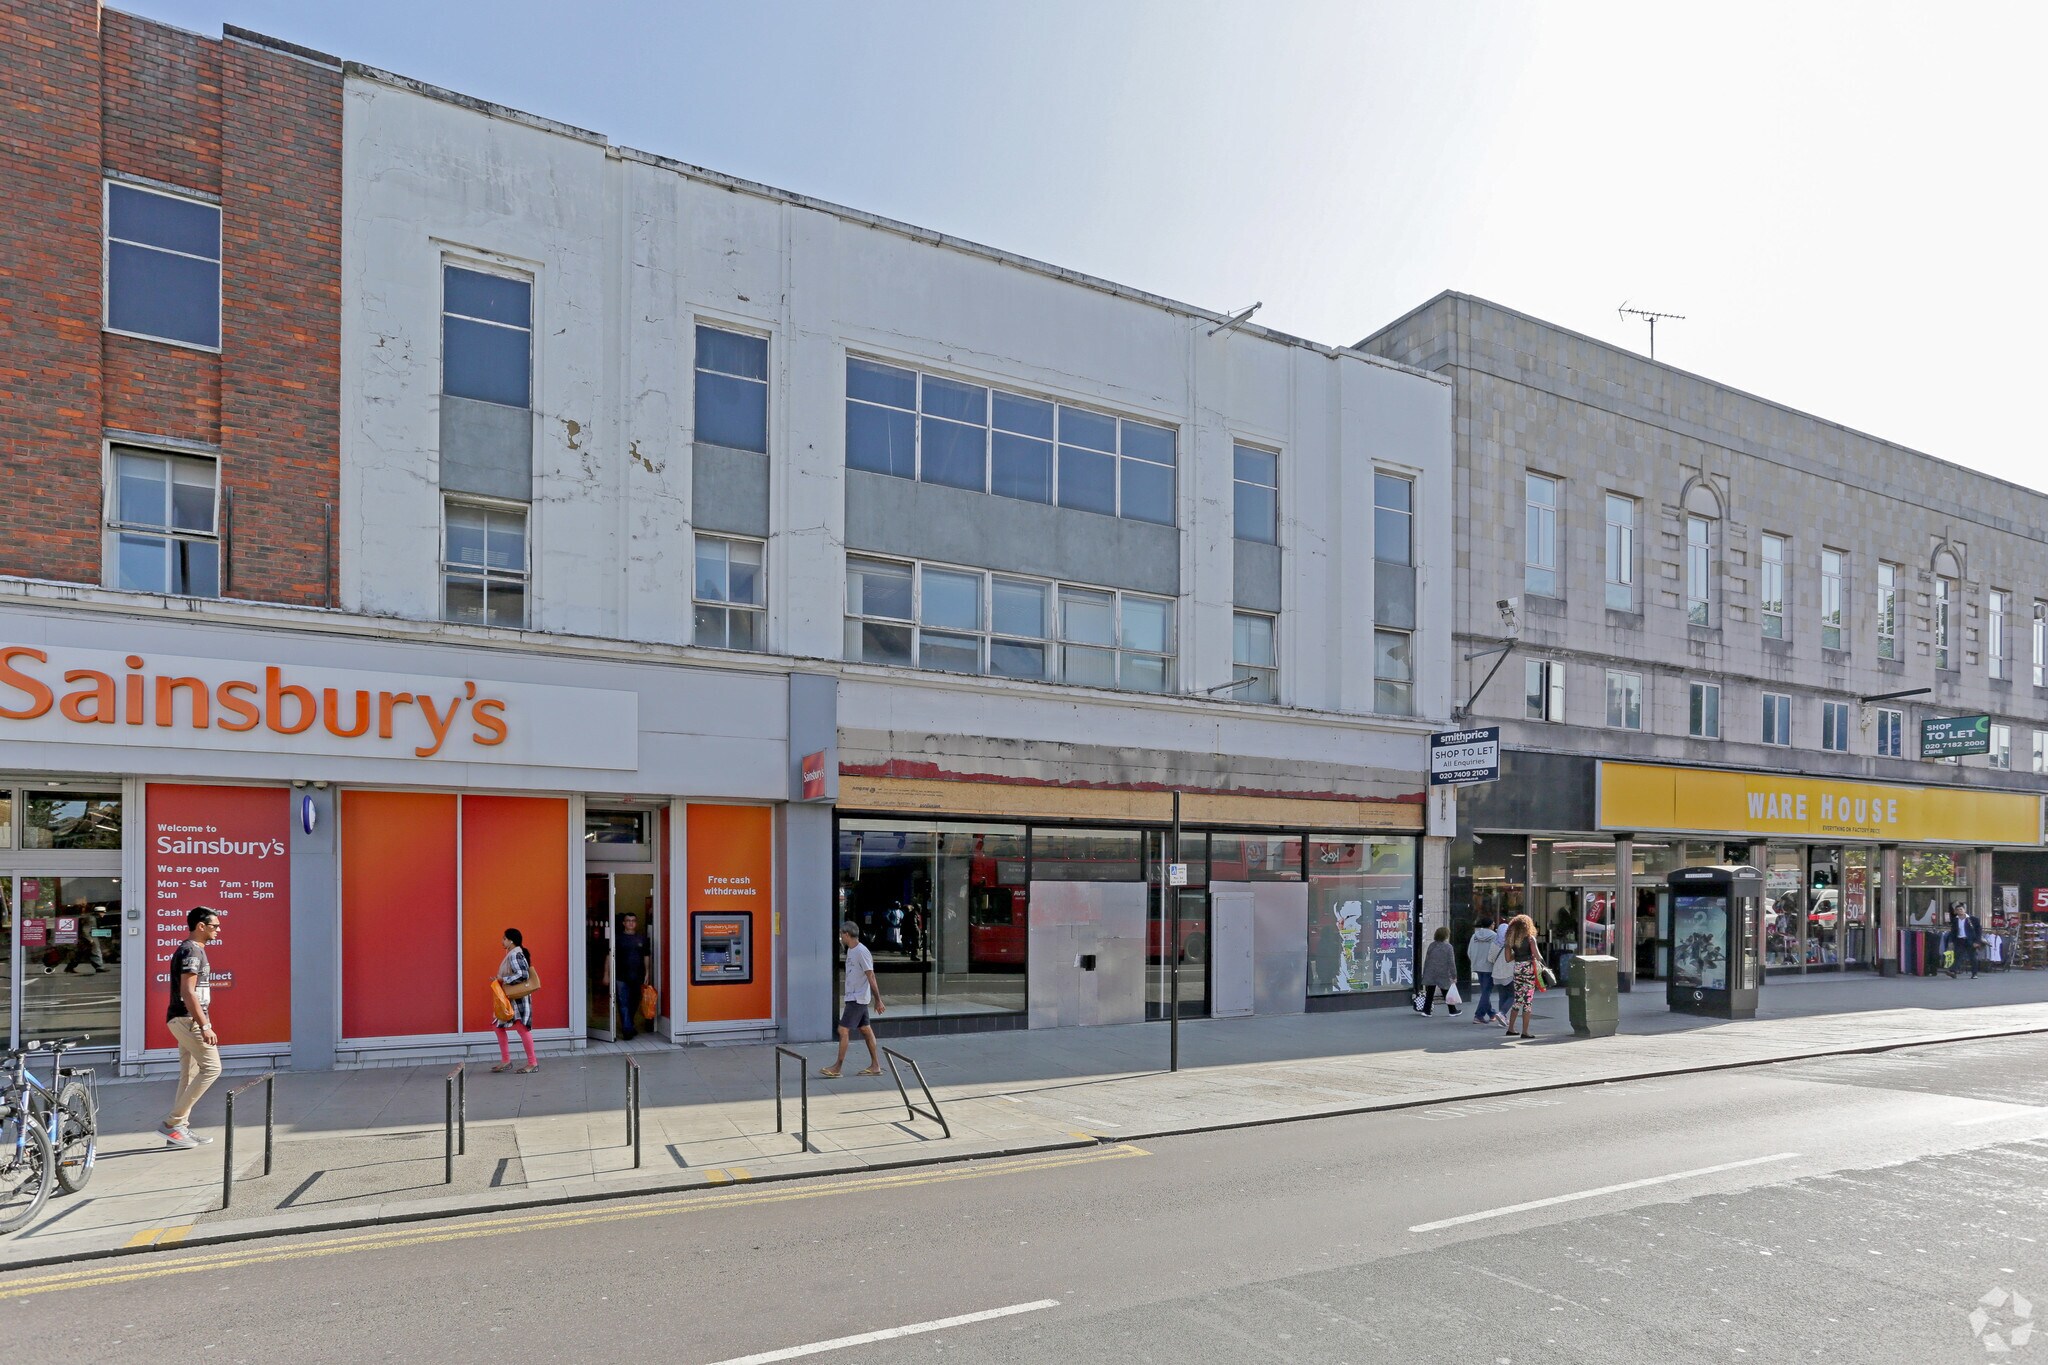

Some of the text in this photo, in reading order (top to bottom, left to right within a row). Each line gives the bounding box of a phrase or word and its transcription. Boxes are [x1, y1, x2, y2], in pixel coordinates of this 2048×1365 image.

[0, 646, 508, 757] Sainsbury's
[1927, 723, 1951, 731] SHOP
[1440, 730, 1489, 743] smithprice
[1926, 729, 1975, 740] TO LET
[1435, 746, 1494, 759] SHOP TO LET
[1454, 759, 1485, 767] Enquiries
[803, 767, 825, 783] Sainsbury's
[1747, 792, 1897, 823] WARE HOUSE
[157, 823, 203, 832] Welcome
[157, 836, 285, 859] Sainsbury's
[157, 865, 173, 873] We
[195, 866, 219, 874] open
[157, 880, 179, 888] Mon
[189, 880, 207, 888] Sat
[220, 880, 241, 888] 7am
[251, 880, 274, 889] 11pm
[708, 876, 750, 884] Free cash
[253, 891, 274, 899] 5pm
[704, 887, 756, 895] withdrawals
[157, 908, 183, 917] Cash
[157, 923, 189, 932] Baker
[1375, 918, 1399, 929] Trevor
[1375, 929, 1403, 940] Nelson
